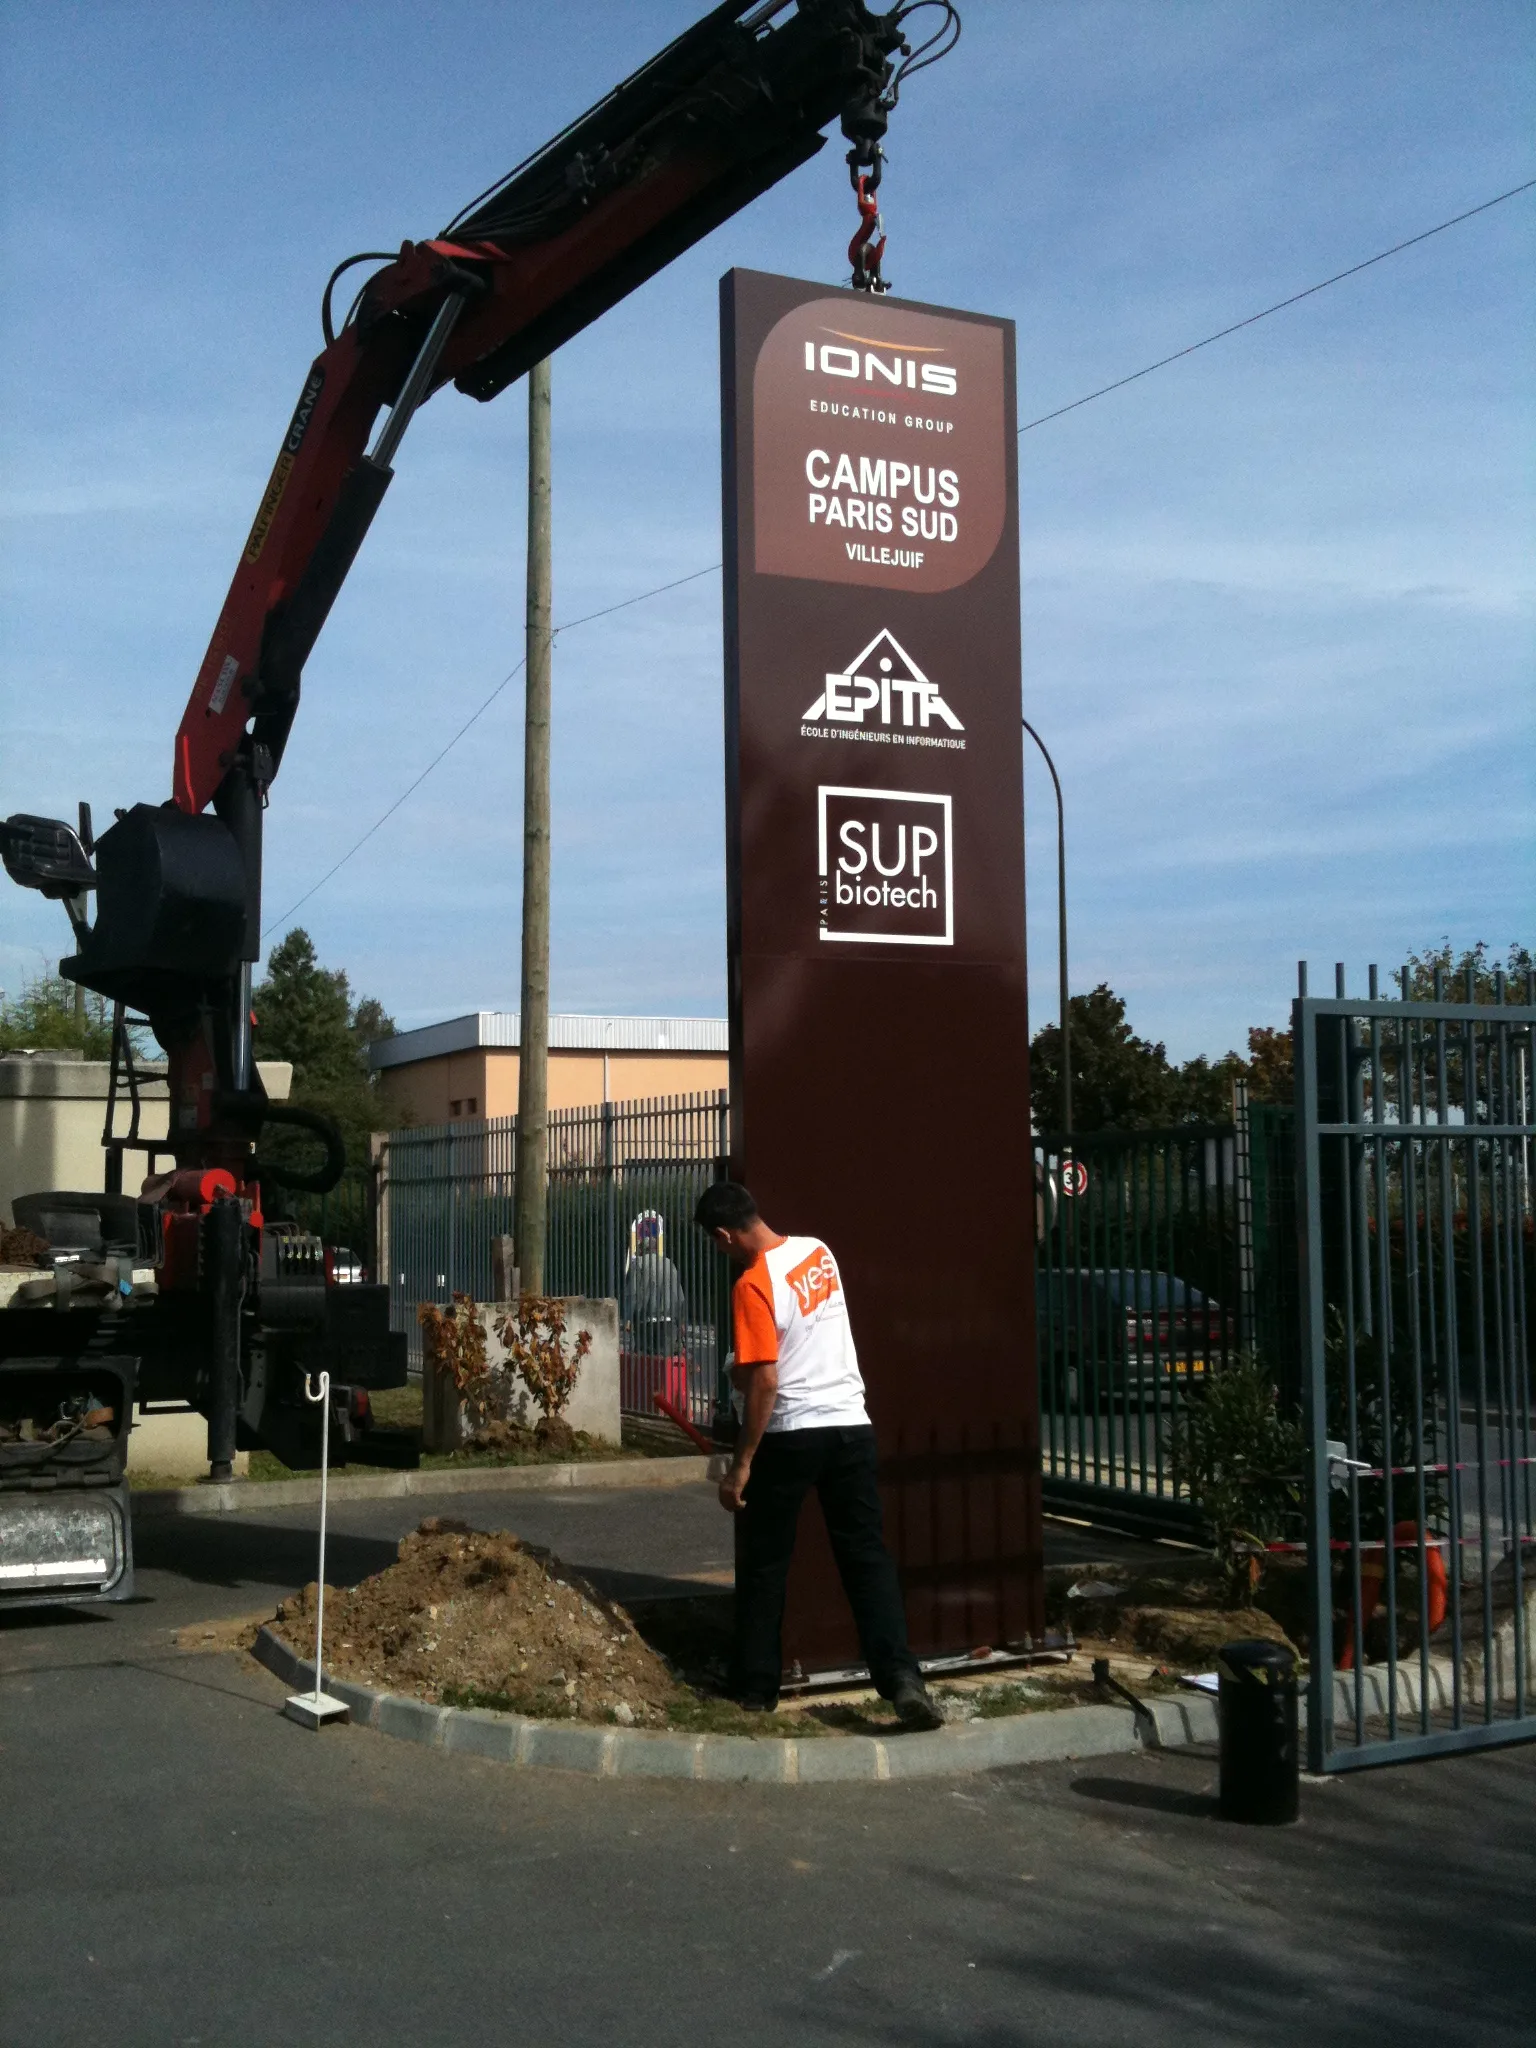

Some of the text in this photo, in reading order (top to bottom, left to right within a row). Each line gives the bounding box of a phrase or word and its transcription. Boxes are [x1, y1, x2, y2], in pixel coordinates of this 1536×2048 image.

[804, 341, 957, 396] IONIS
[288, 374, 324, 451] CRANE
[810, 399, 954, 434] EDUCATION GROUP
[805, 449, 960, 508] CAMPUS
[809, 493, 958, 542] PARIS SUD
[845, 542, 924, 569] VILLEJUIF
[802, 648, 965, 731] EPITA
[801, 724, 829, 738] ÉCOLE
[893, 734, 905, 745] EN
[906, 735, 967, 750] INFORMATIQUE
[838, 820, 938, 878] SUP
[819, 880, 828, 926] PARIS
[836, 869, 937, 909] biotech
[793, 1255, 836, 1309] yes
